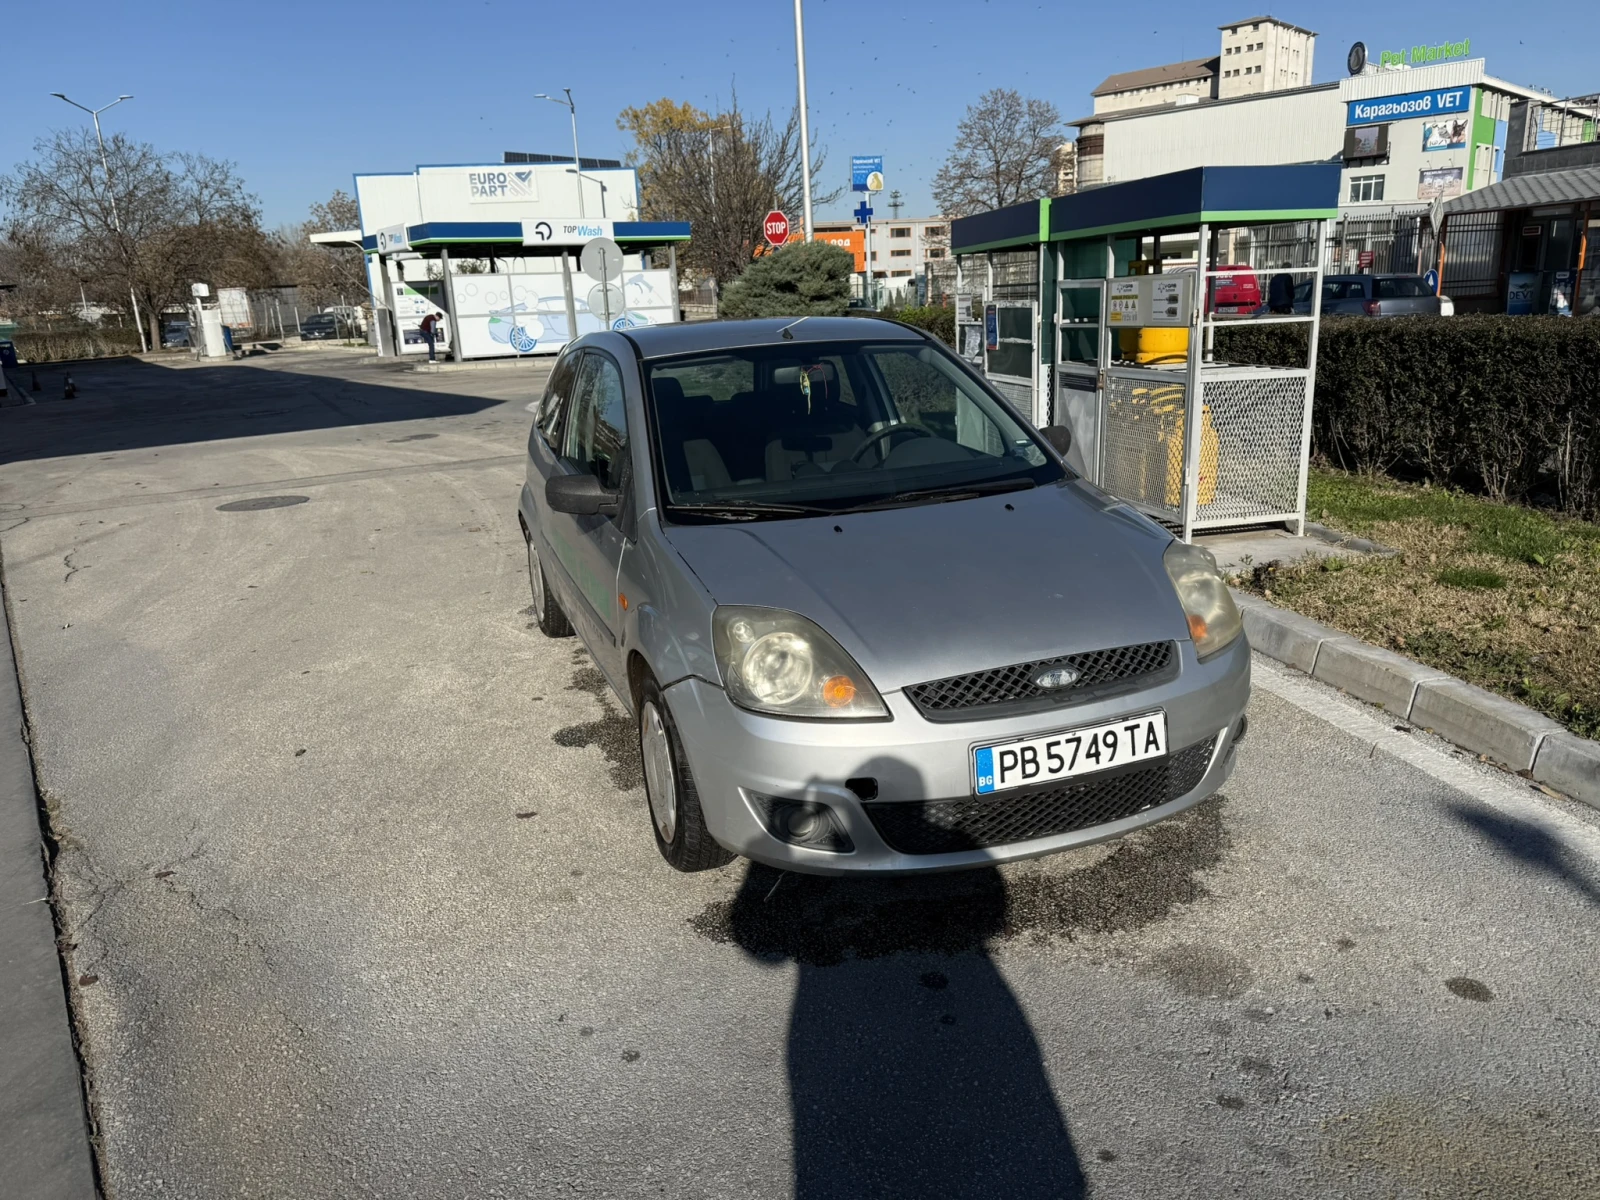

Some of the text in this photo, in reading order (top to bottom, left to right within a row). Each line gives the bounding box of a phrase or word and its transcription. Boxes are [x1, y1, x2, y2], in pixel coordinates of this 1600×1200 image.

[1381, 38, 1470, 68] Pet Market
[1354, 91, 1463, 119] Карагьозов VET
[469, 172, 507, 185] EURO
[470, 185, 508, 197] PART
[766, 221, 786, 235] STOP
[978, 776, 993, 787] BG
